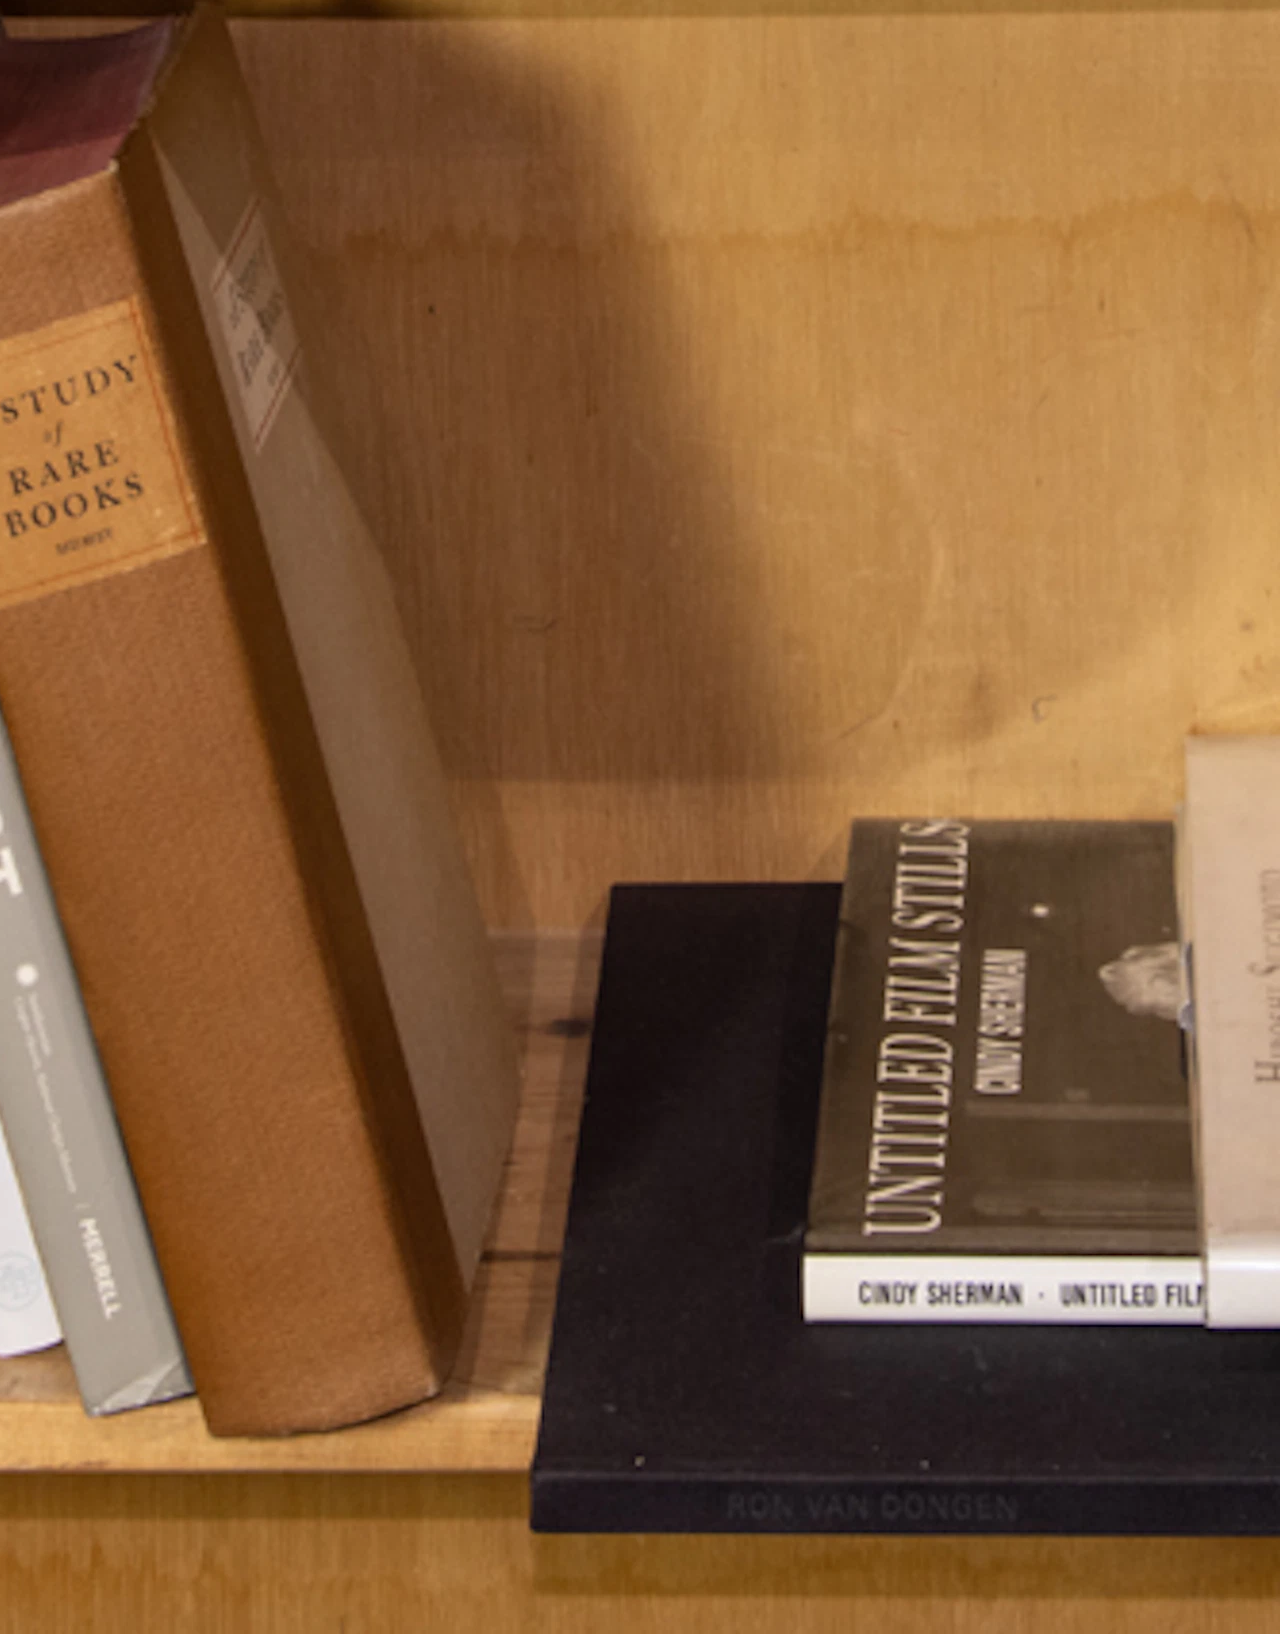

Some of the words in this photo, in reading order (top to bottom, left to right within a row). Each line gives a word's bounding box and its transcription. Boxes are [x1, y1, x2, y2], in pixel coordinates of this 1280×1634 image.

[0, 353, 142, 424] STUDY
[3, 472, 145, 539] BOOKS
[8, 437, 122, 498] RARE
[891, 818, 970, 933] STILLS
[884, 936, 962, 1026] FILM
[864, 1032, 955, 1236] UNTITLED
[79, 1217, 121, 1320] MERRELL
[857, 1282, 919, 1306] CINDY
[927, 1282, 1025, 1306] SHERMAN
[1060, 1282, 1157, 1306] UNTITLED
